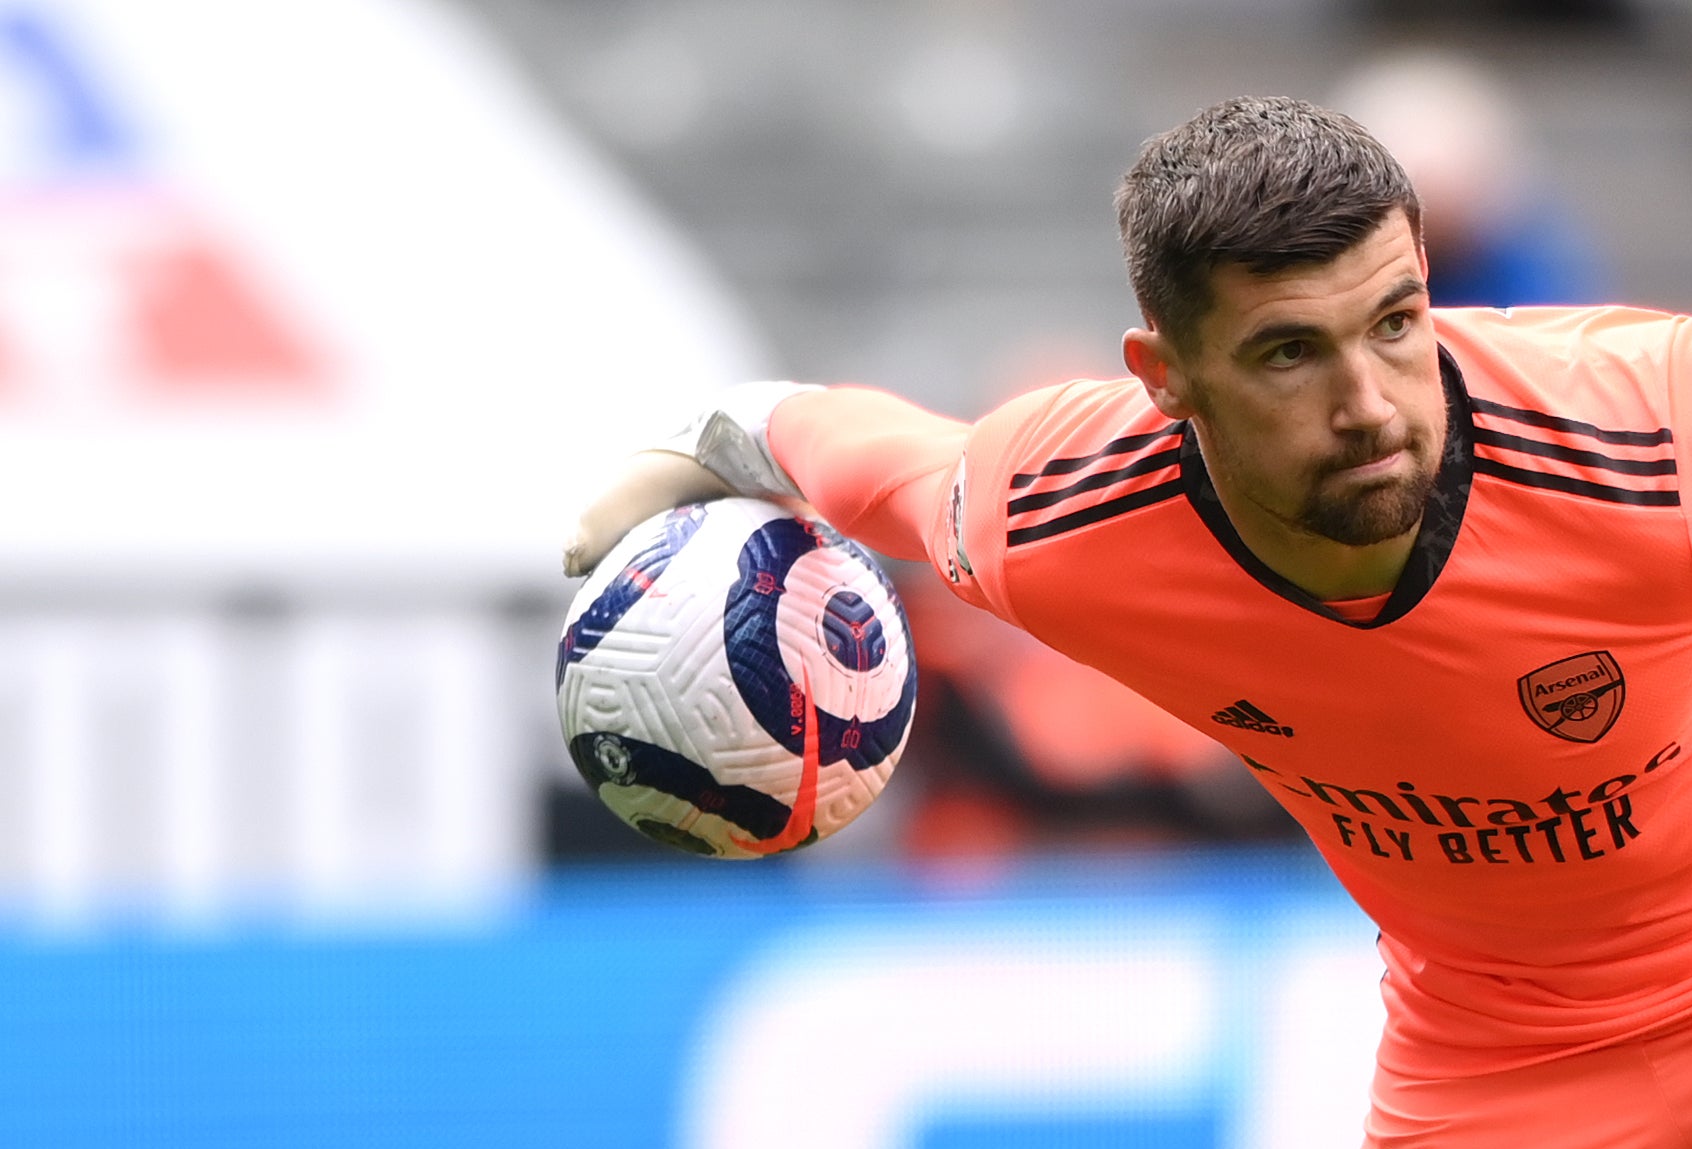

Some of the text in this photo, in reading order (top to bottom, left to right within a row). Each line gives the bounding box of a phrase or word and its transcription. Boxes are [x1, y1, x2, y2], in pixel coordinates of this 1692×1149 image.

[1535, 664, 1606, 697] Arsenal
[1211, 715, 1295, 738] adidas
[1332, 793, 1641, 864] FLY BETTER
